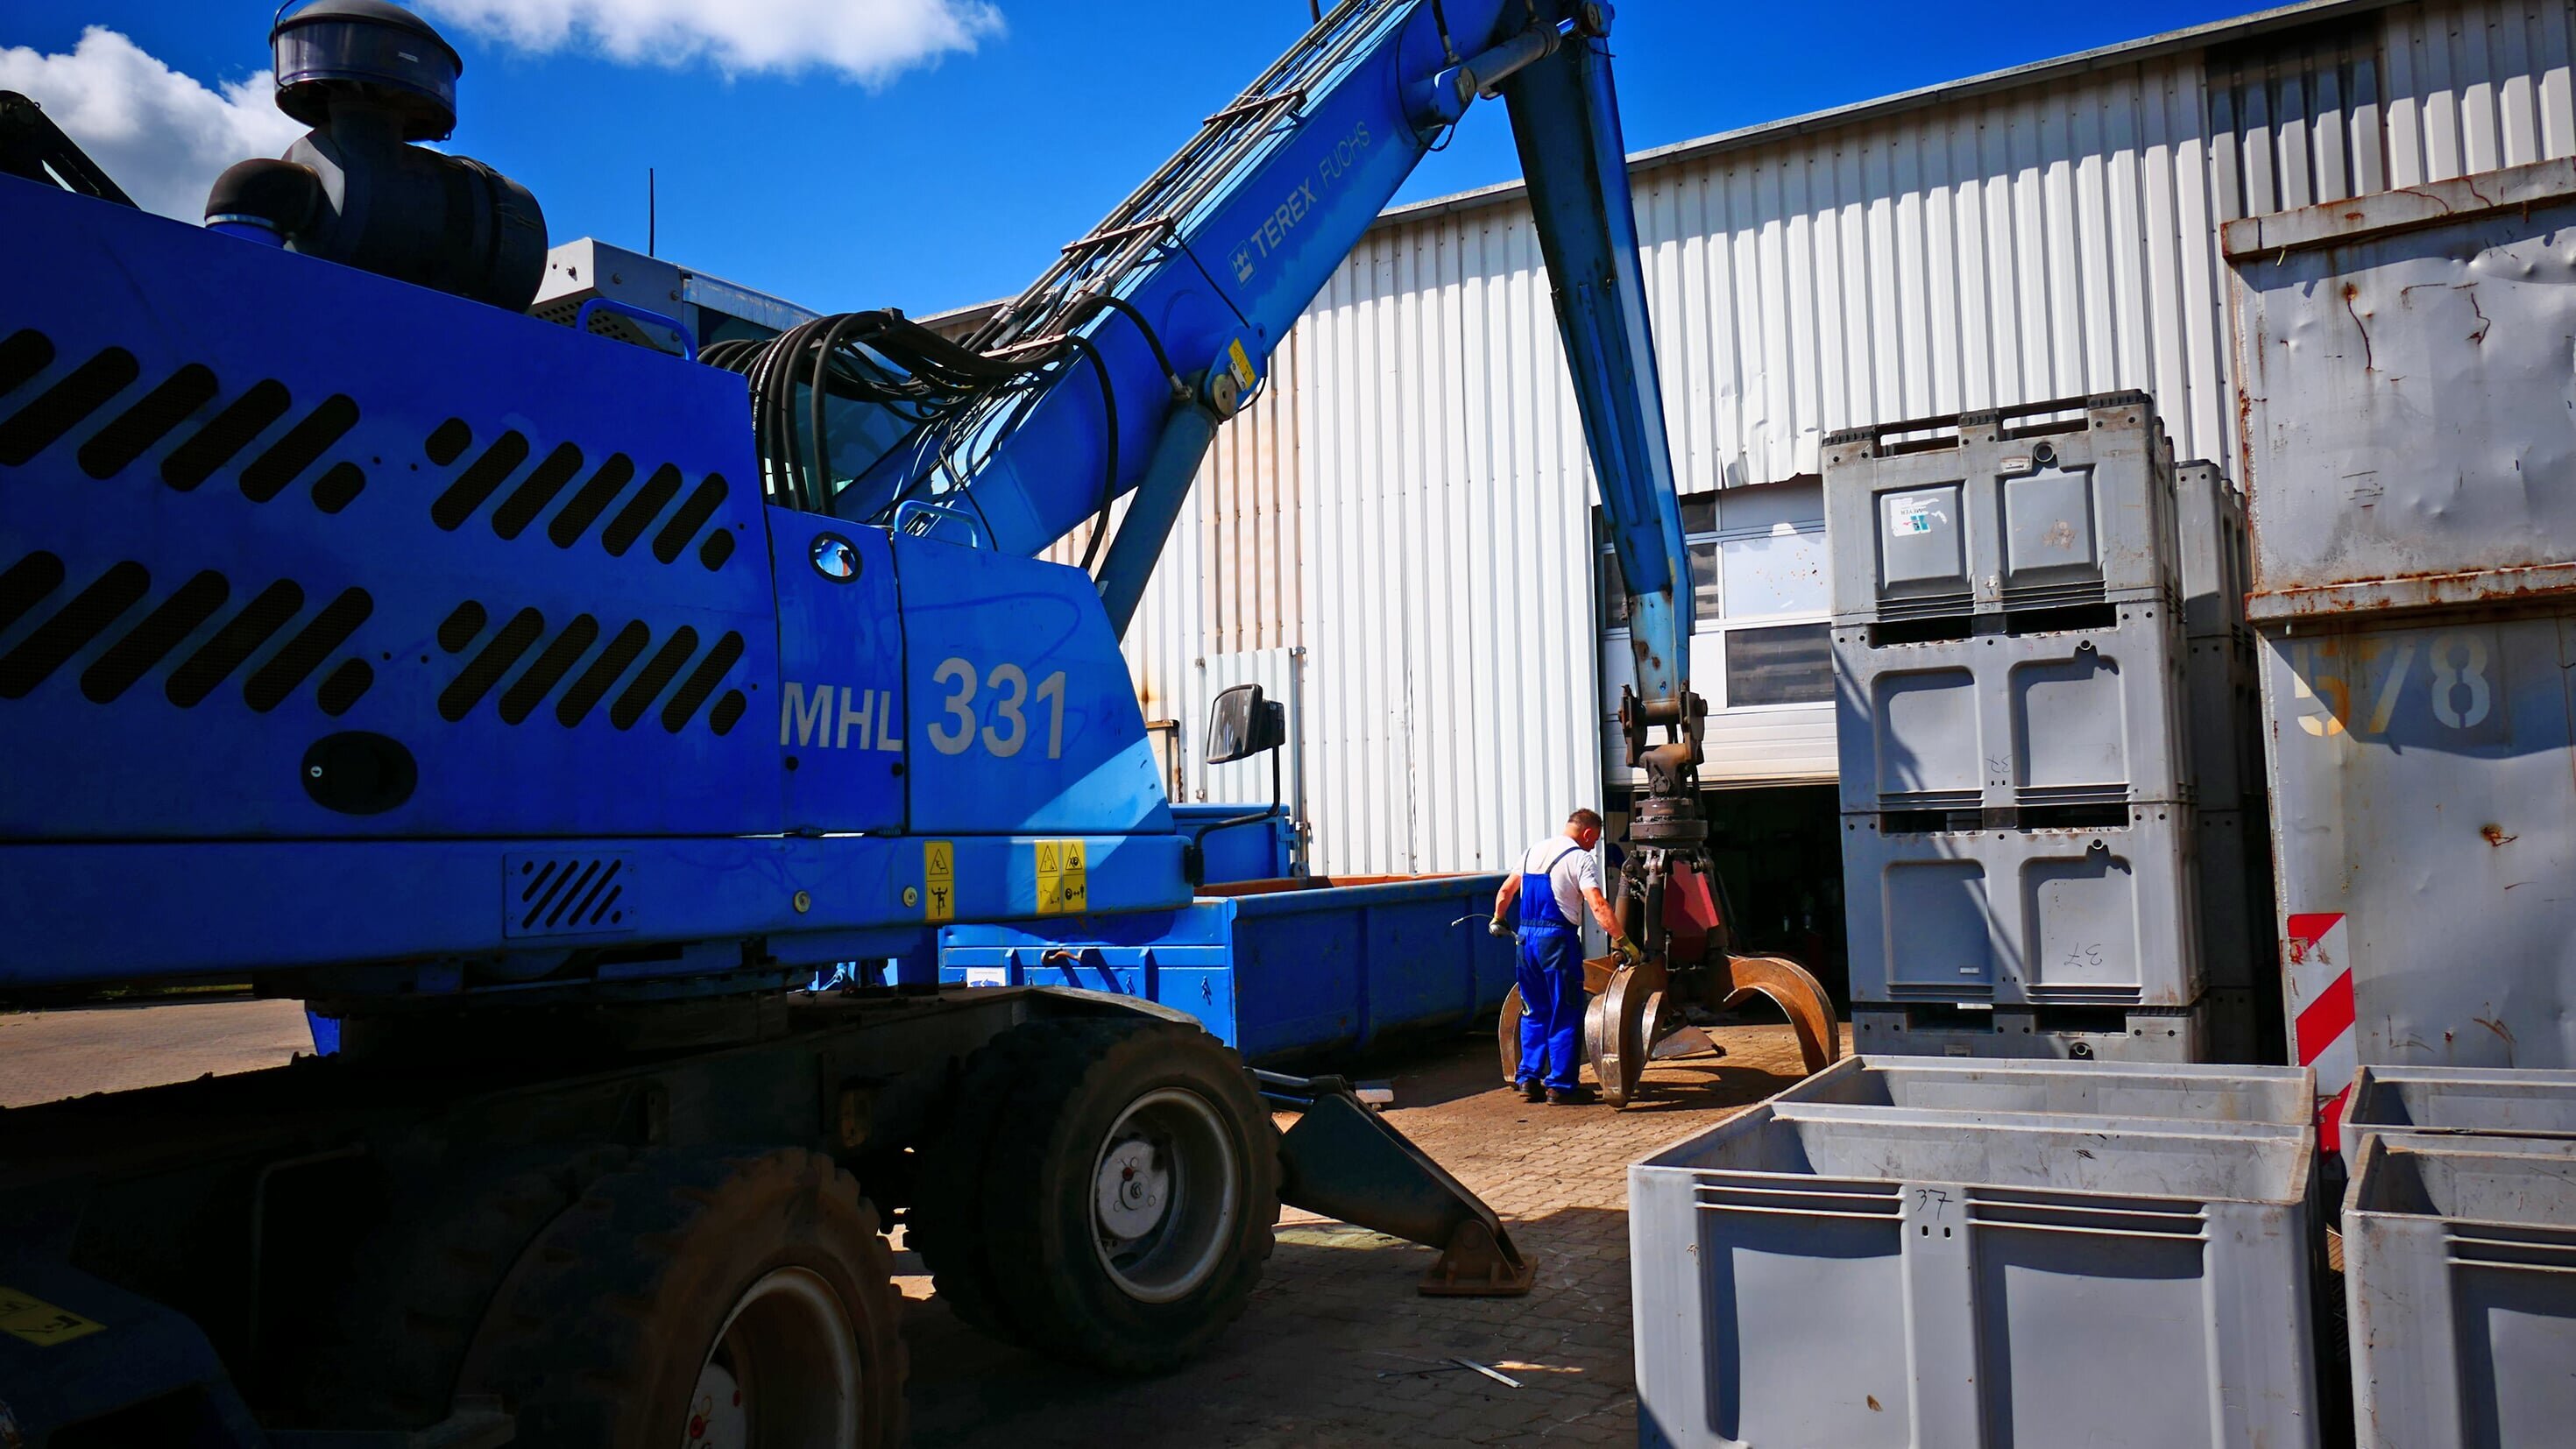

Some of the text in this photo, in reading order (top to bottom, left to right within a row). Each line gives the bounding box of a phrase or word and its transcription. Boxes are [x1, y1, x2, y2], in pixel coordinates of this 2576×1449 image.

[1251, 121, 1370, 258] TEREX FUCHS
[780, 656, 1066, 760] MHL 331
[2063, 942, 2103, 968] 37
[1915, 1188, 1954, 1220] 37
